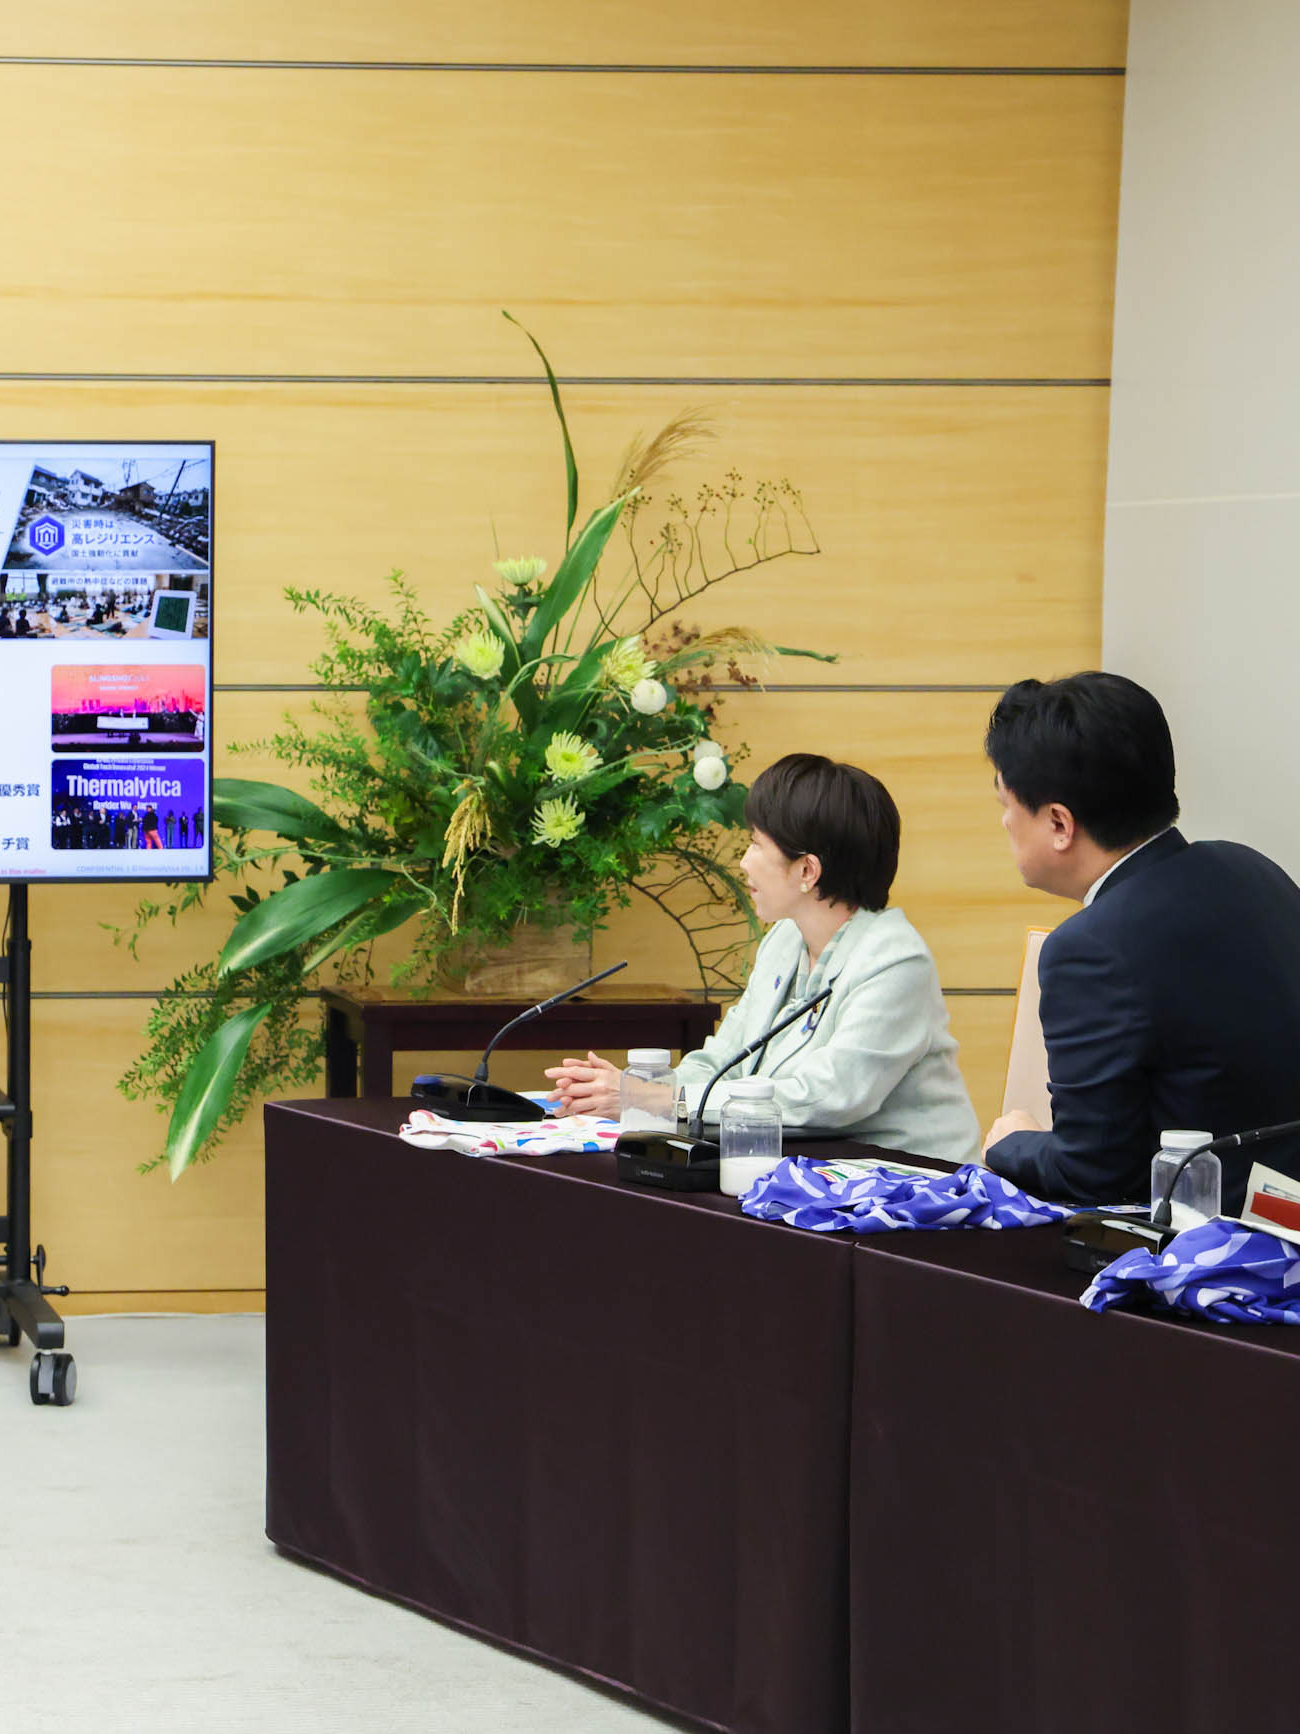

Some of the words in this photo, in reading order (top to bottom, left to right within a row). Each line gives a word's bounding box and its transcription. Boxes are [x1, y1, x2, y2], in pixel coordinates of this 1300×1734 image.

[72, 532, 155, 545] 高レジリエンス
[66, 775, 181, 798] Thermalytica
